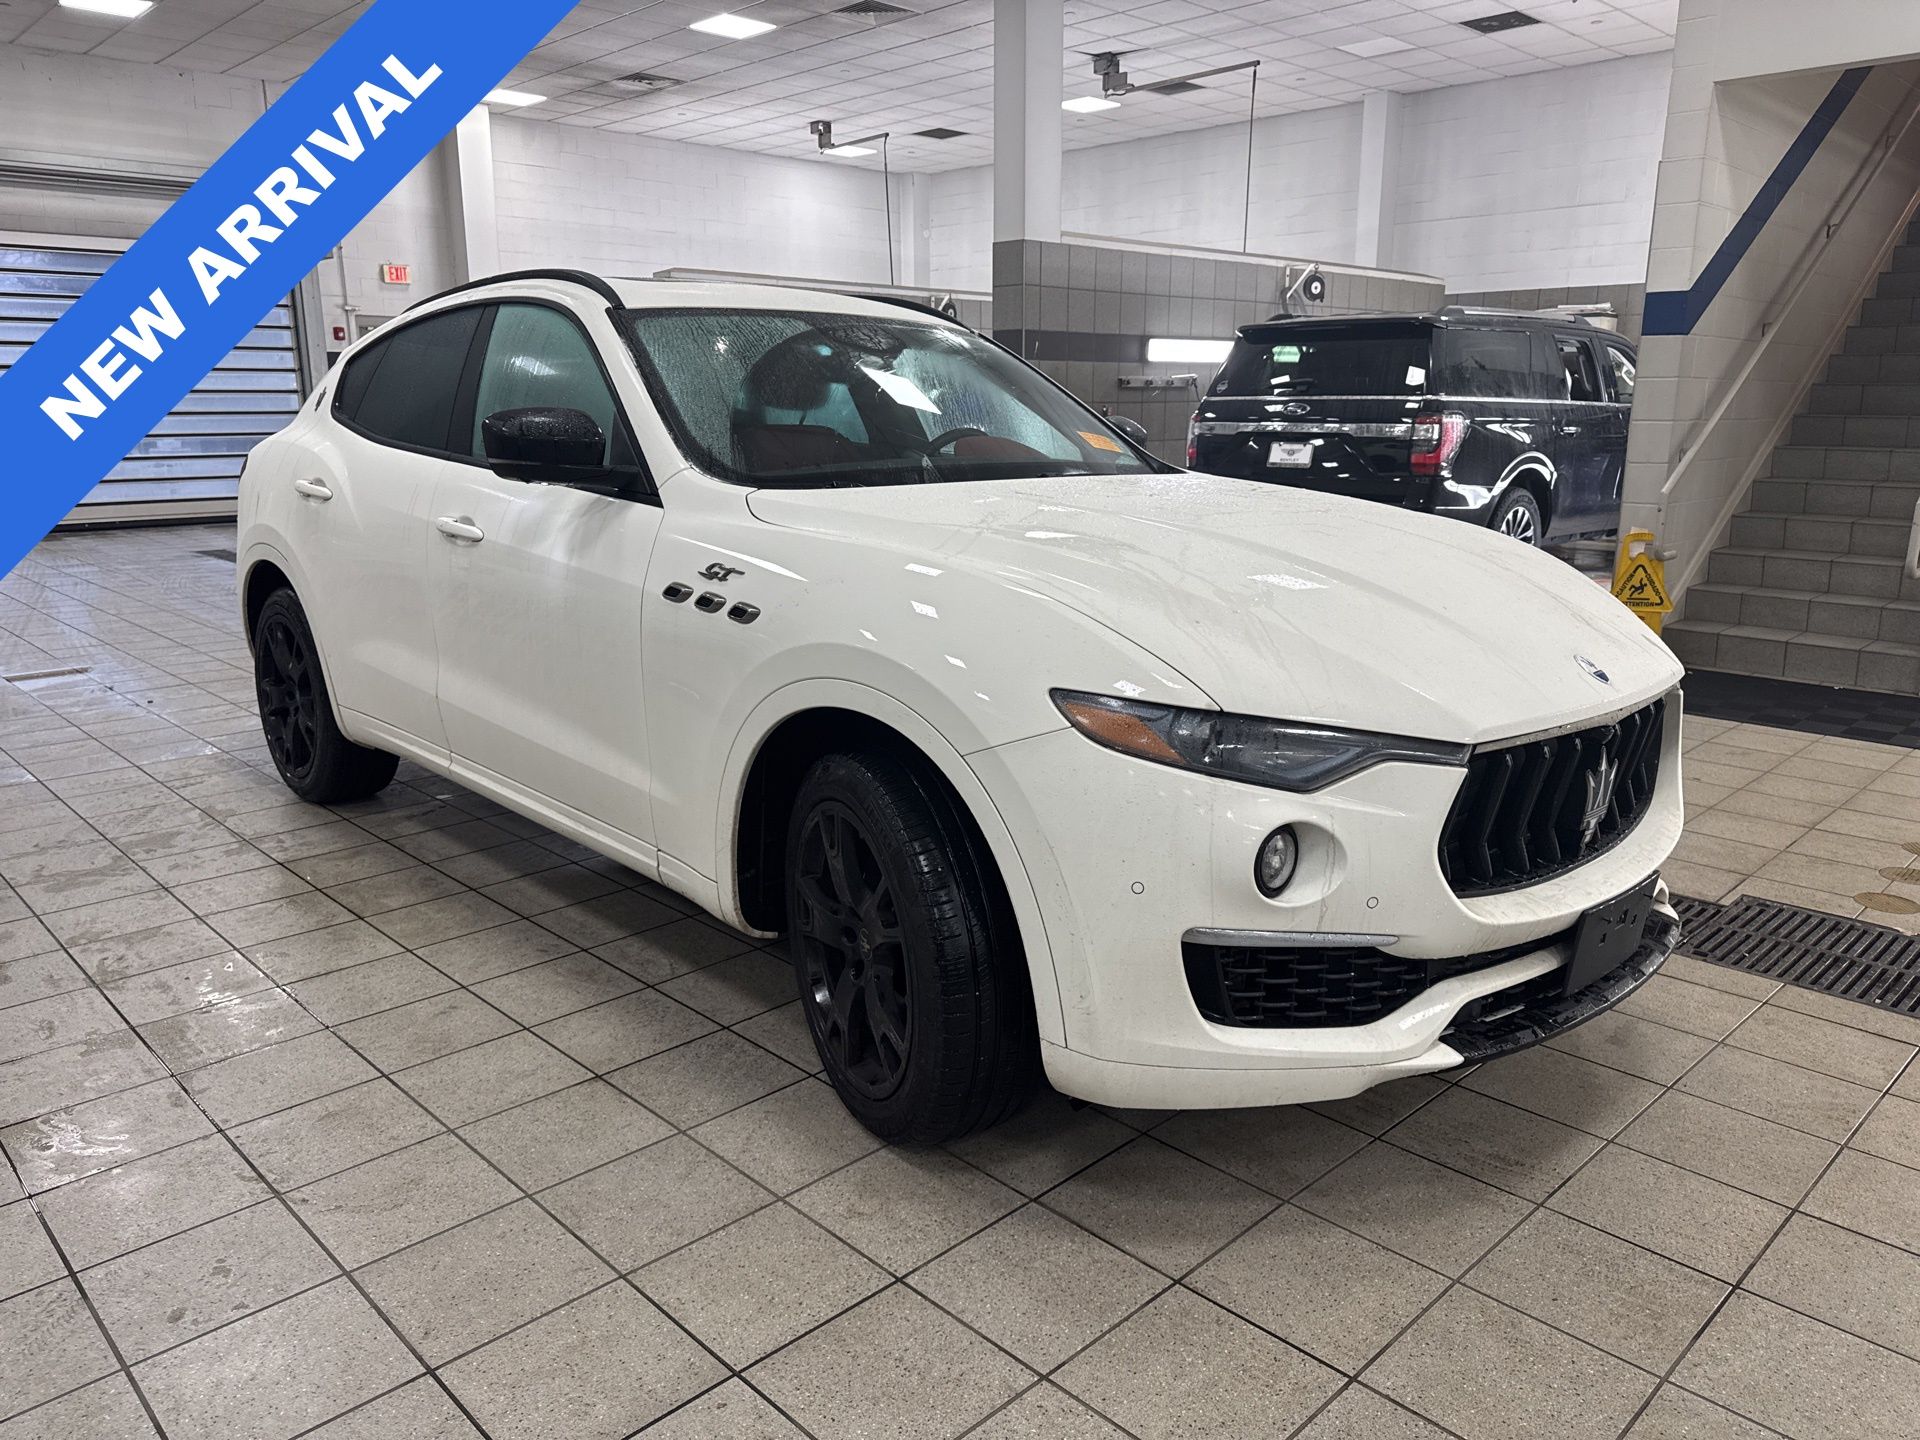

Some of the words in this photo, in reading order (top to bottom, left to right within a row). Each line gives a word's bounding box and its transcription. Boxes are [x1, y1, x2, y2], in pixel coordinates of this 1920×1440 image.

[388, 266, 407, 282] EXIT
[1617, 573, 1635, 596] CAUTION
[1645, 573, 1661, 597] CUIDADO
